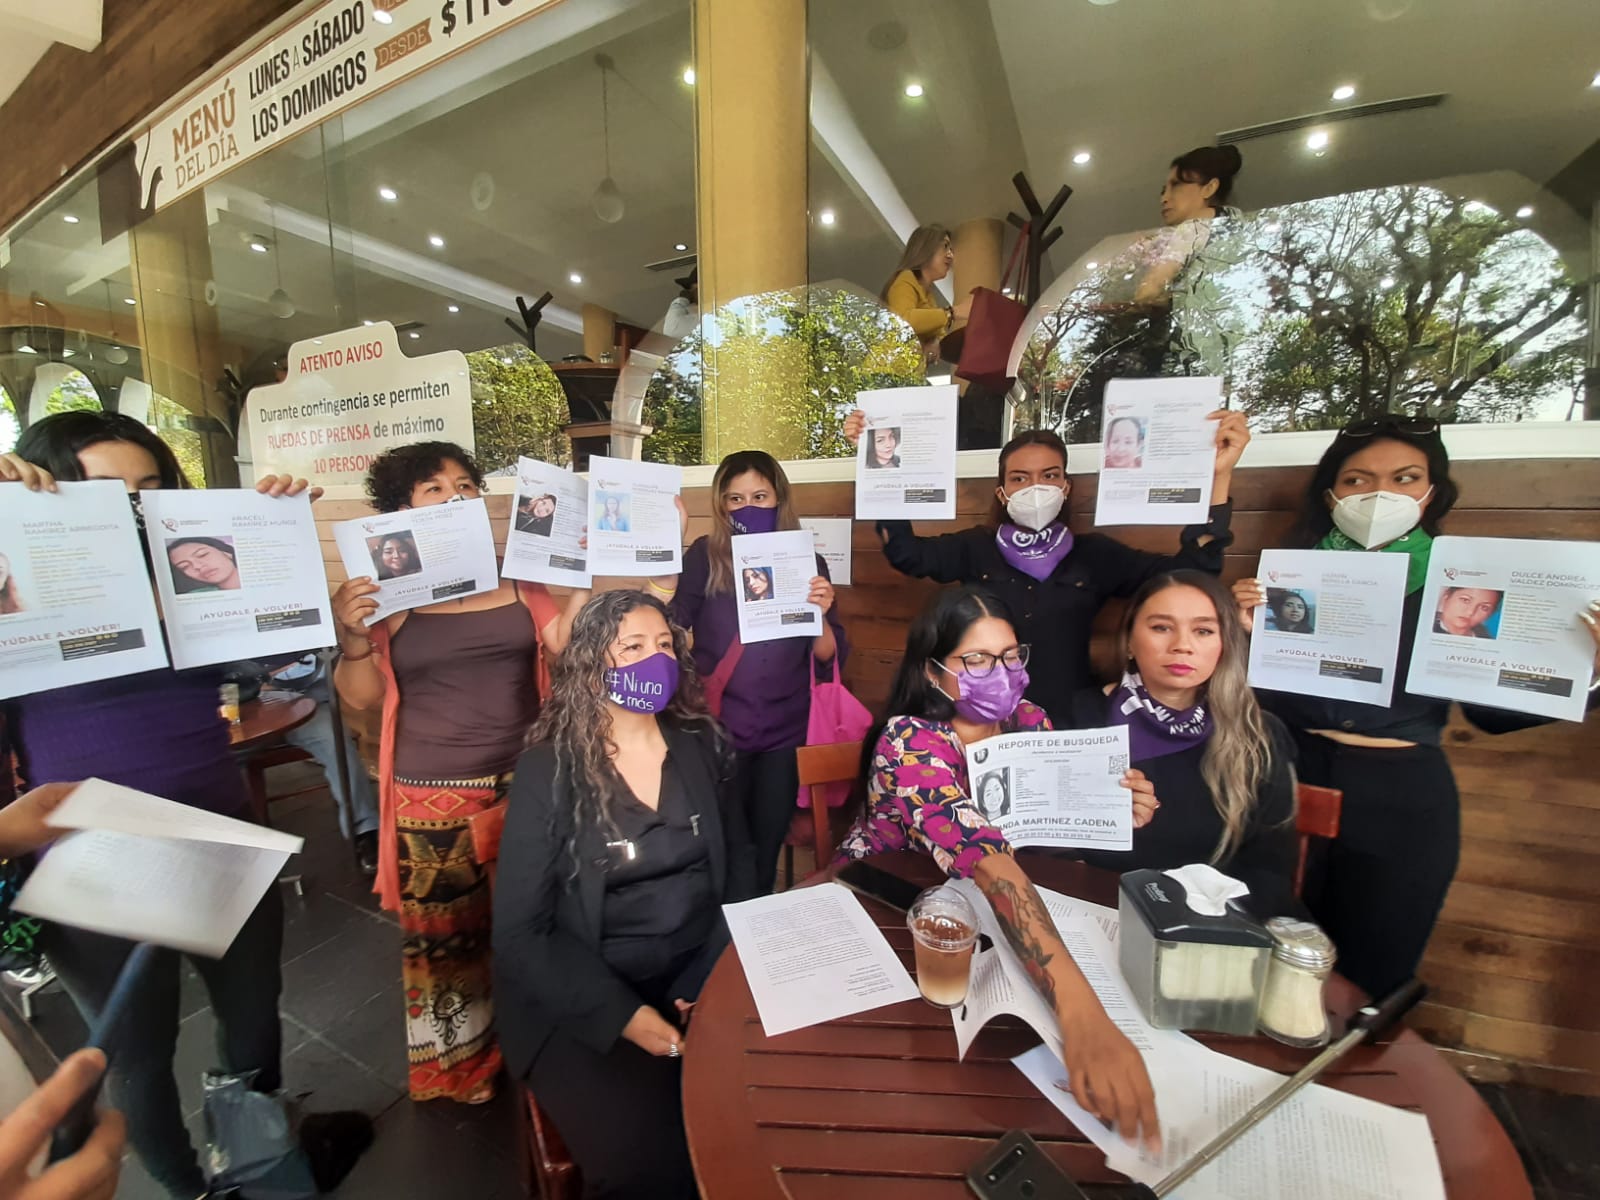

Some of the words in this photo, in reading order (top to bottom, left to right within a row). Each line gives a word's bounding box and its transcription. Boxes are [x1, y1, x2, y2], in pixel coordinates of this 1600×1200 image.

[249, 48, 290, 100] LUNES
[293, 45, 301, 72] A
[302, 1, 365, 67] SÁBADO
[252, 102, 279, 143] LOS
[281, 50, 368, 127] DOMINGOS
[378, 25, 428, 67] DESDE
[172, 78, 236, 163] MENÚ
[175, 152, 206, 189] DEL
[208, 130, 240, 168] DÍA
[300, 349, 343, 374] ATENTO
[345, 340, 383, 367] AVISO
[259, 403, 299, 423] Durante
[301, 393, 370, 421] contingencia
[373, 394, 386, 407] se
[390, 381, 451, 408] permiten
[268, 428, 308, 449] RUEDAS
[310, 427, 324, 445] DE
[326, 423, 371, 444] PRENSA
[374, 420, 389, 438] de
[392, 416, 445, 436] máximo
[314, 458, 326, 474] 10
[1511, 571, 1544, 579] DULCE
[1545, 573, 1587, 582] ANDREA
[1511, 663, 1557, 675] VOLVER!
[640, 681, 663, 695] una
[627, 695, 655, 711] más
[998, 739, 1044, 752] REPORTE
[1046, 738, 1060, 747] DE
[1063, 735, 1119, 747] BUSQUEDA
[1022, 817, 1071, 826] MARTINEZ
[1074, 818, 1118, 828] CADENA
